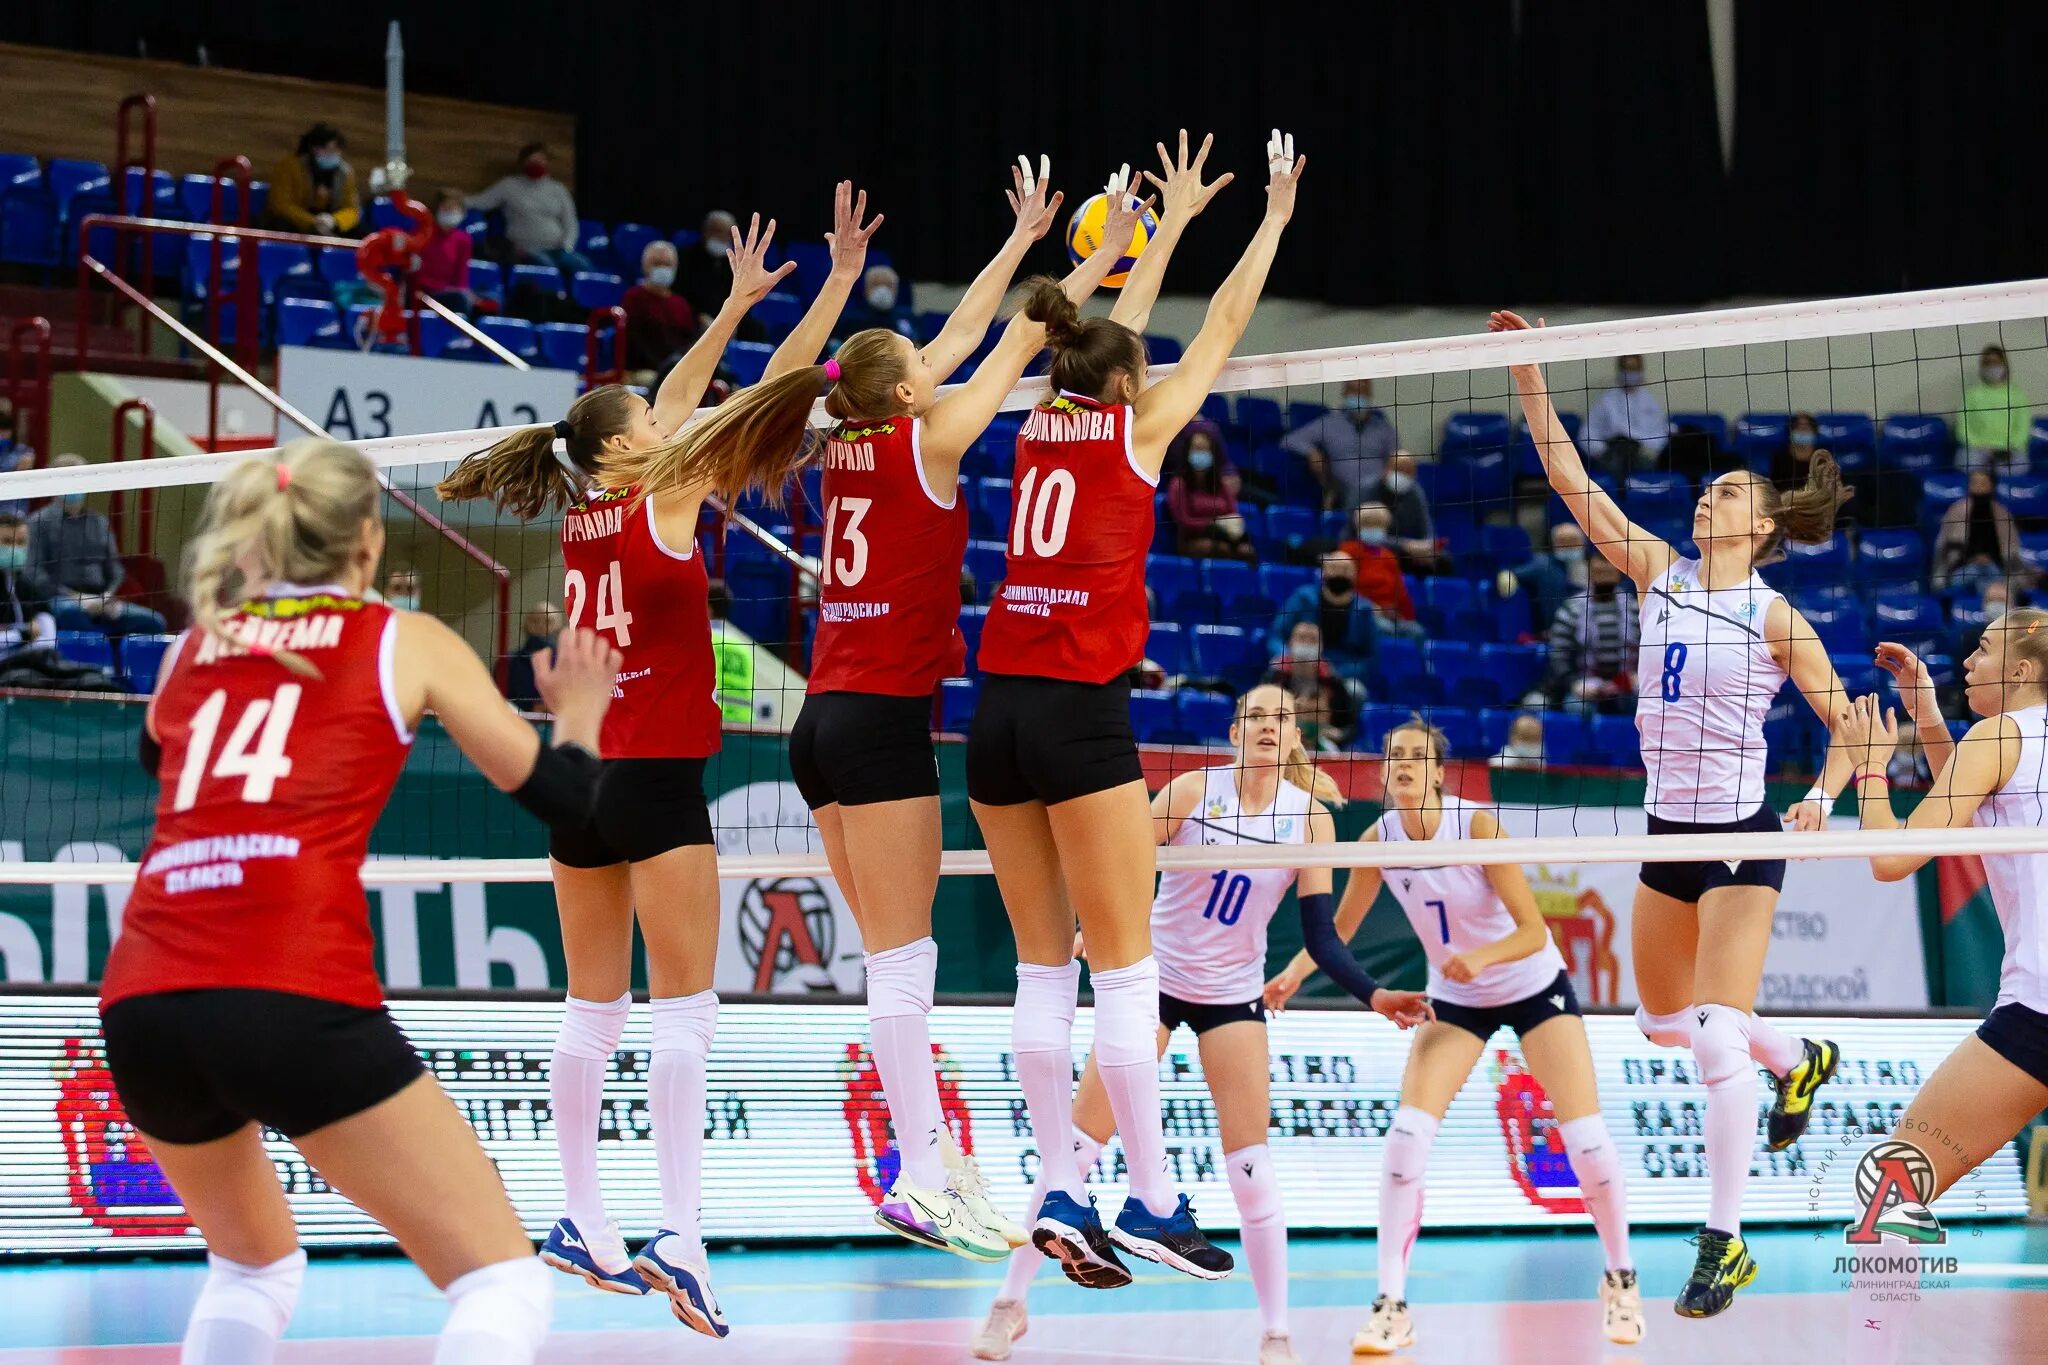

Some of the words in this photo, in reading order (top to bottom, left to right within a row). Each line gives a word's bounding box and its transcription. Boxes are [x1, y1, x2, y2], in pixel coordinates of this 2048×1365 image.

[823, 496, 873, 587] 13
[1013, 466, 1076, 558] 10
[564, 561, 632, 647] 24
[1661, 642, 1688, 703] 8
[174, 683, 303, 812] 14
[1203, 869, 1252, 926] 10
[1425, 900, 1450, 945] 7
